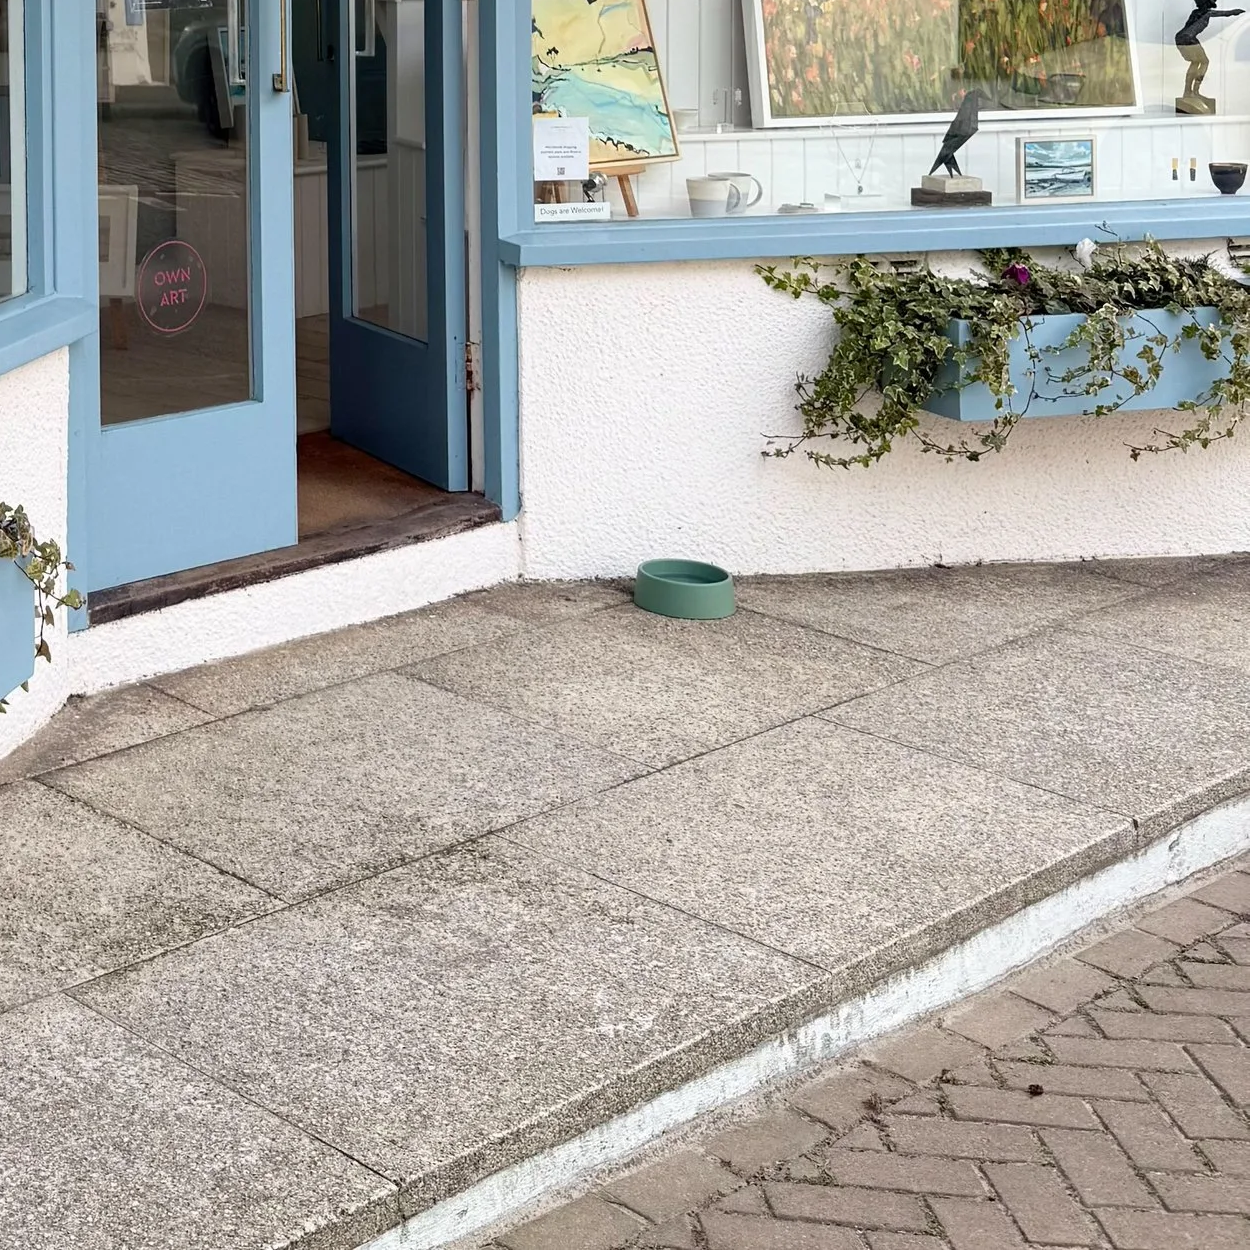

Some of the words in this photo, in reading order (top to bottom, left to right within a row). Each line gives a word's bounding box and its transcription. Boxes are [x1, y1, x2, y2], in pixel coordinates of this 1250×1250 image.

[540, 207, 558, 215] Dogs
[154, 266, 190, 286] OWN
[160, 289, 187, 306] ART
